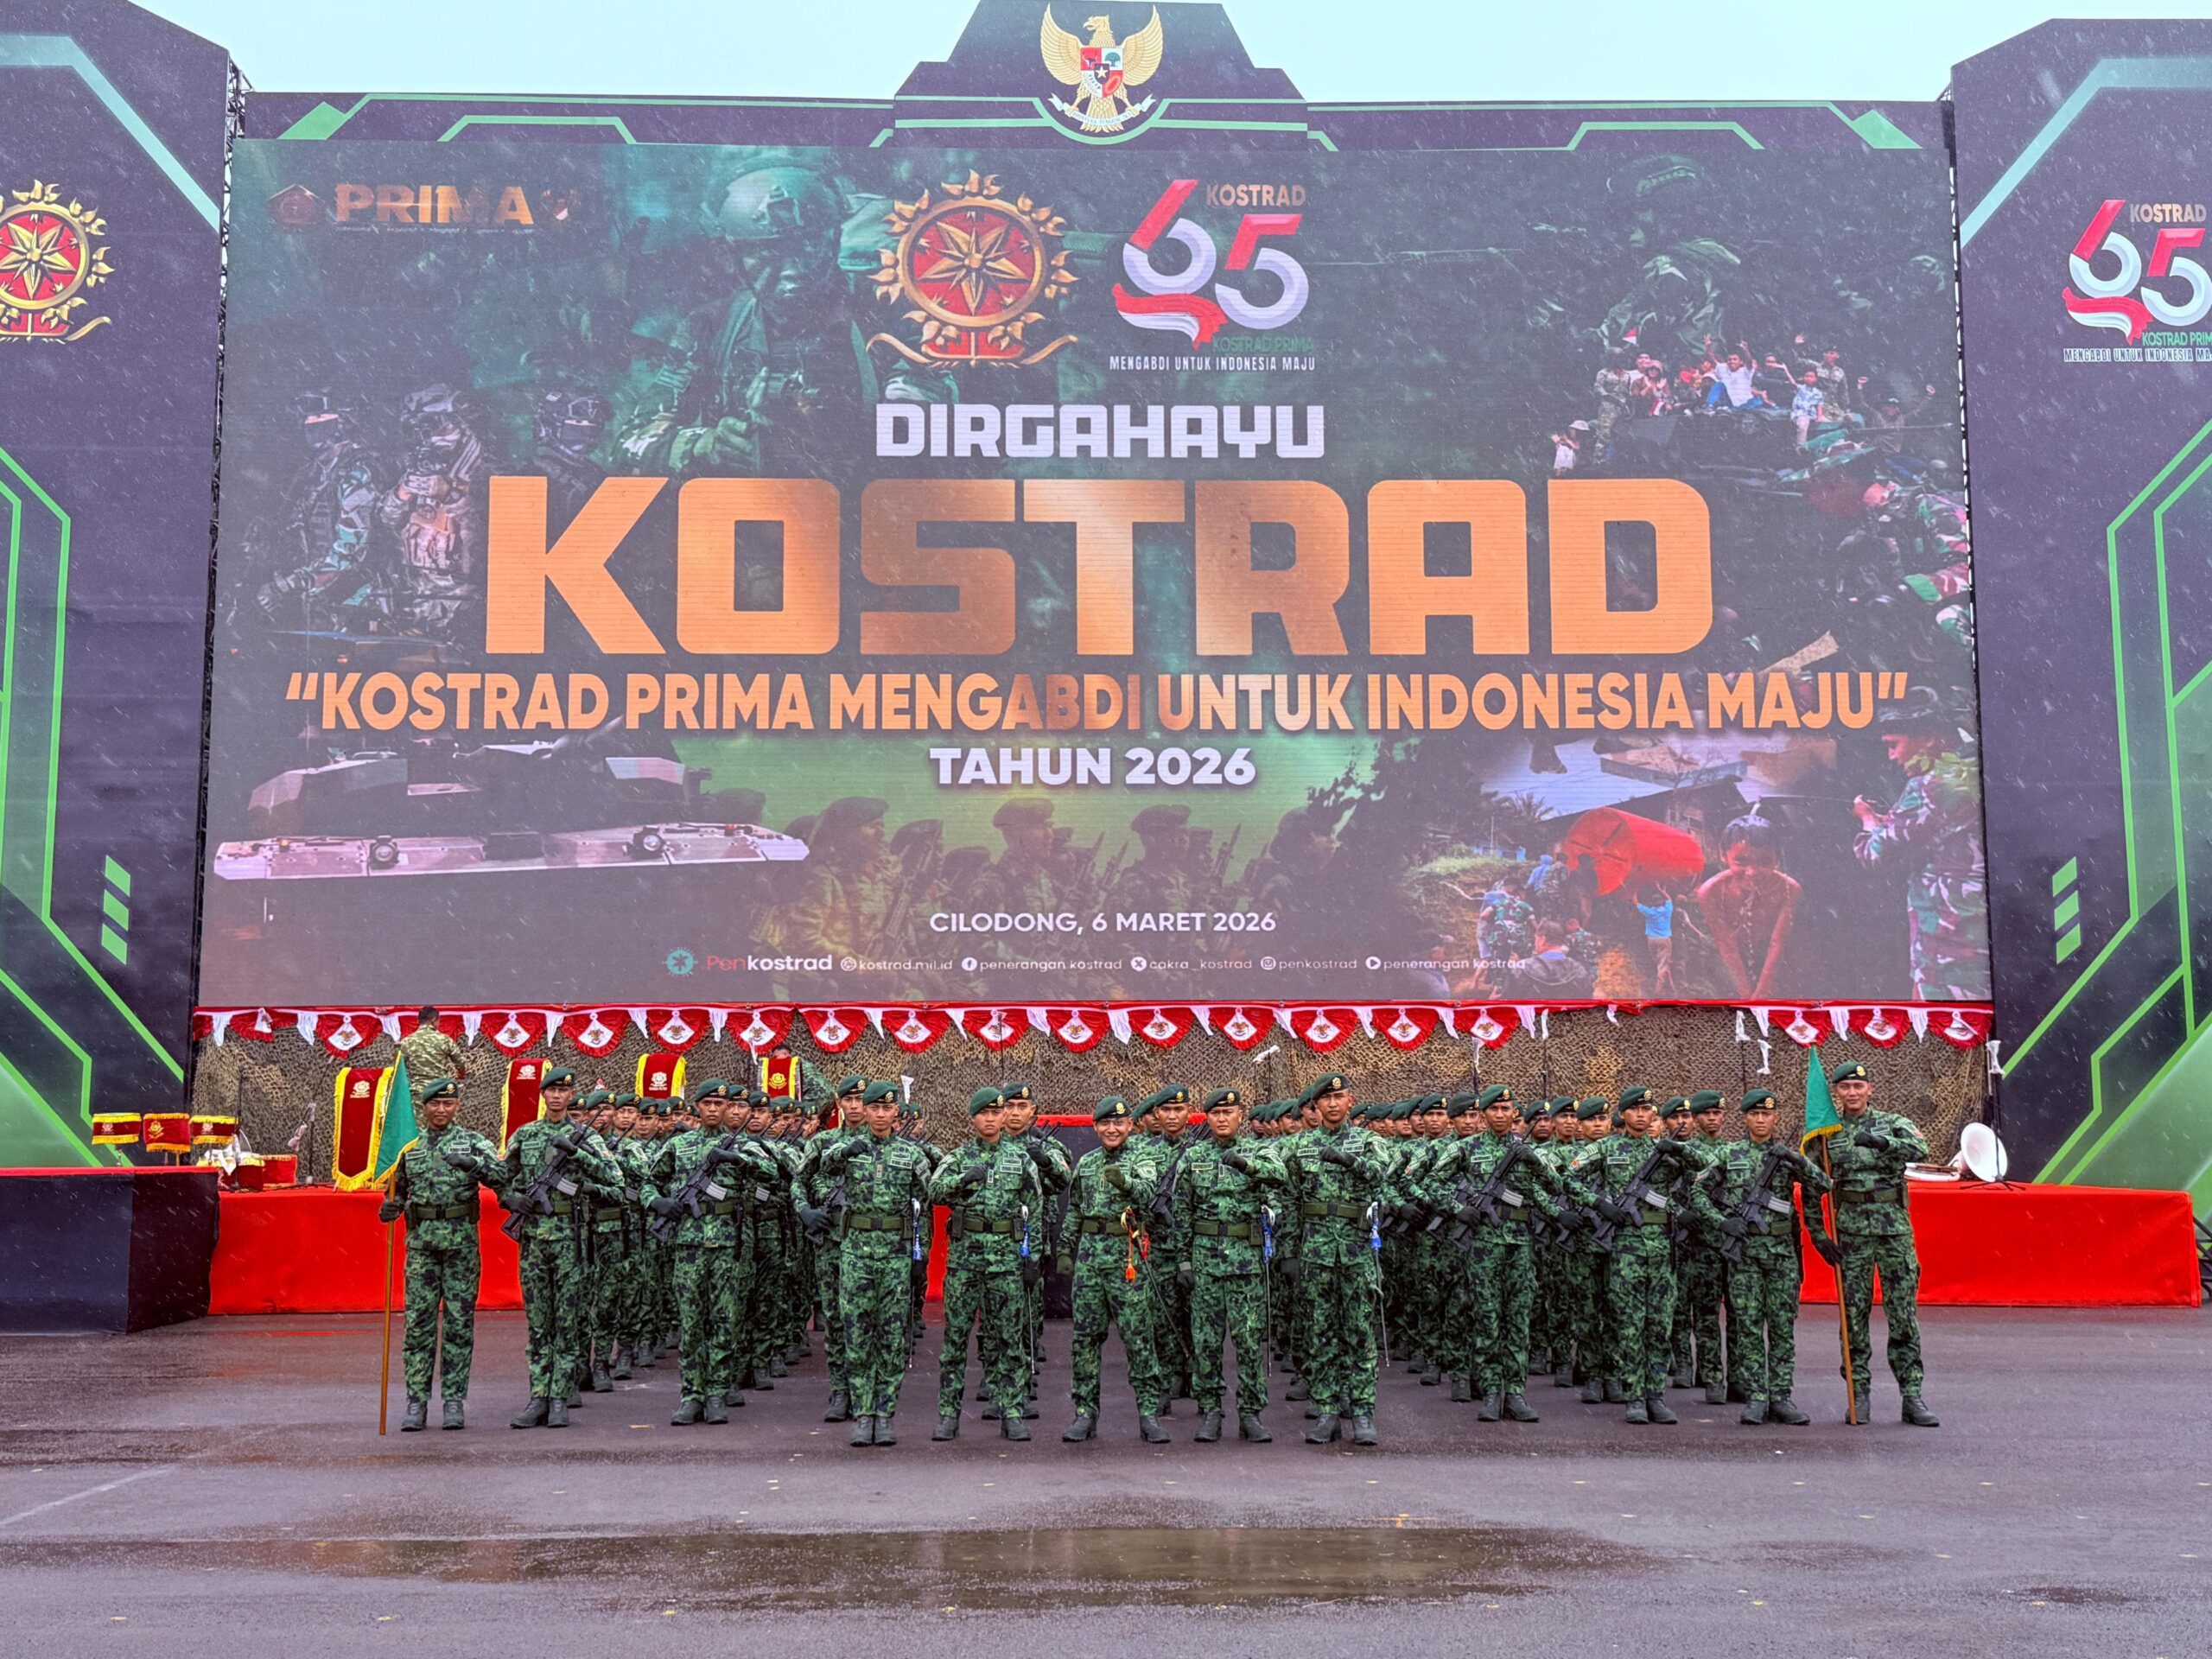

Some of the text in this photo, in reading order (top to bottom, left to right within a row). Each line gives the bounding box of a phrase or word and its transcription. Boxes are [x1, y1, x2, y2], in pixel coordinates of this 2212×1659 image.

[335, 184, 534, 225] PRIMA
[1206, 183, 1306, 207] KOSTRAD
[2130, 204, 2207, 222] KOSTRAD
[1122, 179, 1309, 330] 65
[2069, 200, 2212, 327] 65
[1212, 336, 1272, 353] KOSTRAD
[2142, 332, 2188, 346] KOSTRAD
[1109, 356, 1315, 371] MENGABDI UNTUK INDONESIA MAJU
[2063, 348, 2111, 362] MENGABDI
[2113, 348, 2143, 362] UNTUK
[2145, 348, 2193, 362] INDONESIA
[876, 404, 1325, 458] DIRGAHAYU
[486, 475, 1713, 655] KOSTRAD
[626, 673, 814, 729] PRIMA
[830, 673, 1141, 730] MENGABDI
[1158, 673, 1354, 731] UNTUK
[1367, 672, 1694, 730] INDONESIA
[930, 747, 1256, 785] TAHUN 2026
[929, 912, 1276, 935] CILODONG, 6 MARET 2026
[706, 954, 833, 971] Penkostrad
[859, 958, 953, 971] kostrad.mil.id
[1279, 958, 1357, 971] penkostrad
